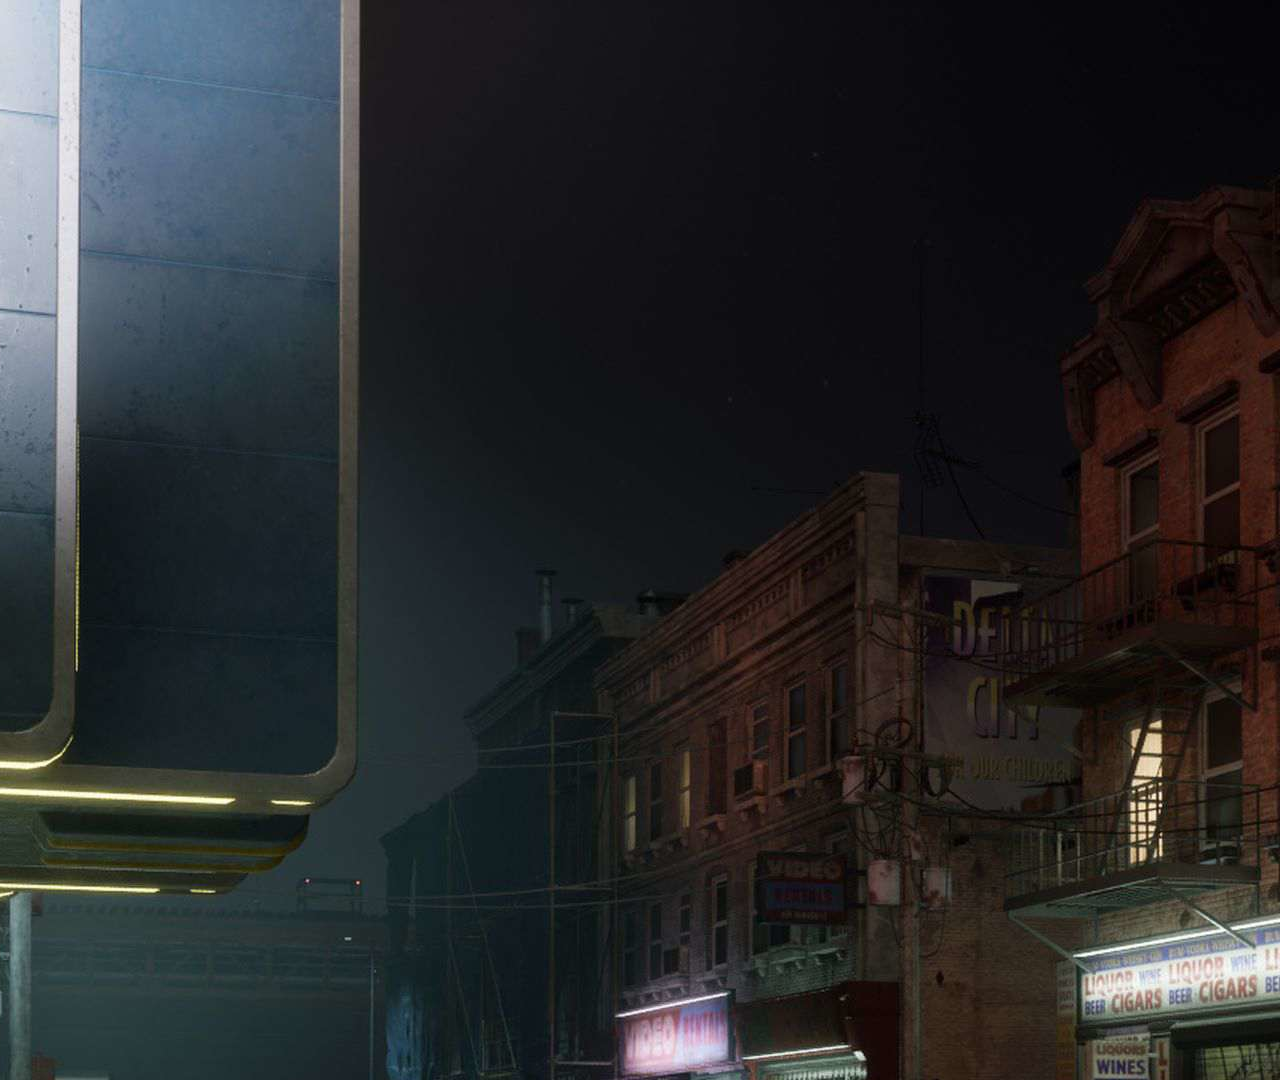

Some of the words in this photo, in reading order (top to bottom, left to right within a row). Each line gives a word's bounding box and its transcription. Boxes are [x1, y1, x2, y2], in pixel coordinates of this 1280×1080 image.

[767, 859, 842, 880] VIDEO
[1084, 970, 1133, 997] LIQUOR
[1168, 957, 1225, 984] LIQUOR
[1085, 999, 1106, 1015] BEER
[1111, 987, 1162, 1014] CIGARS
[1169, 987, 1193, 1004] BEER
[1199, 975, 1258, 1003] CIGARS
[1096, 1060, 1146, 1075] WINES
